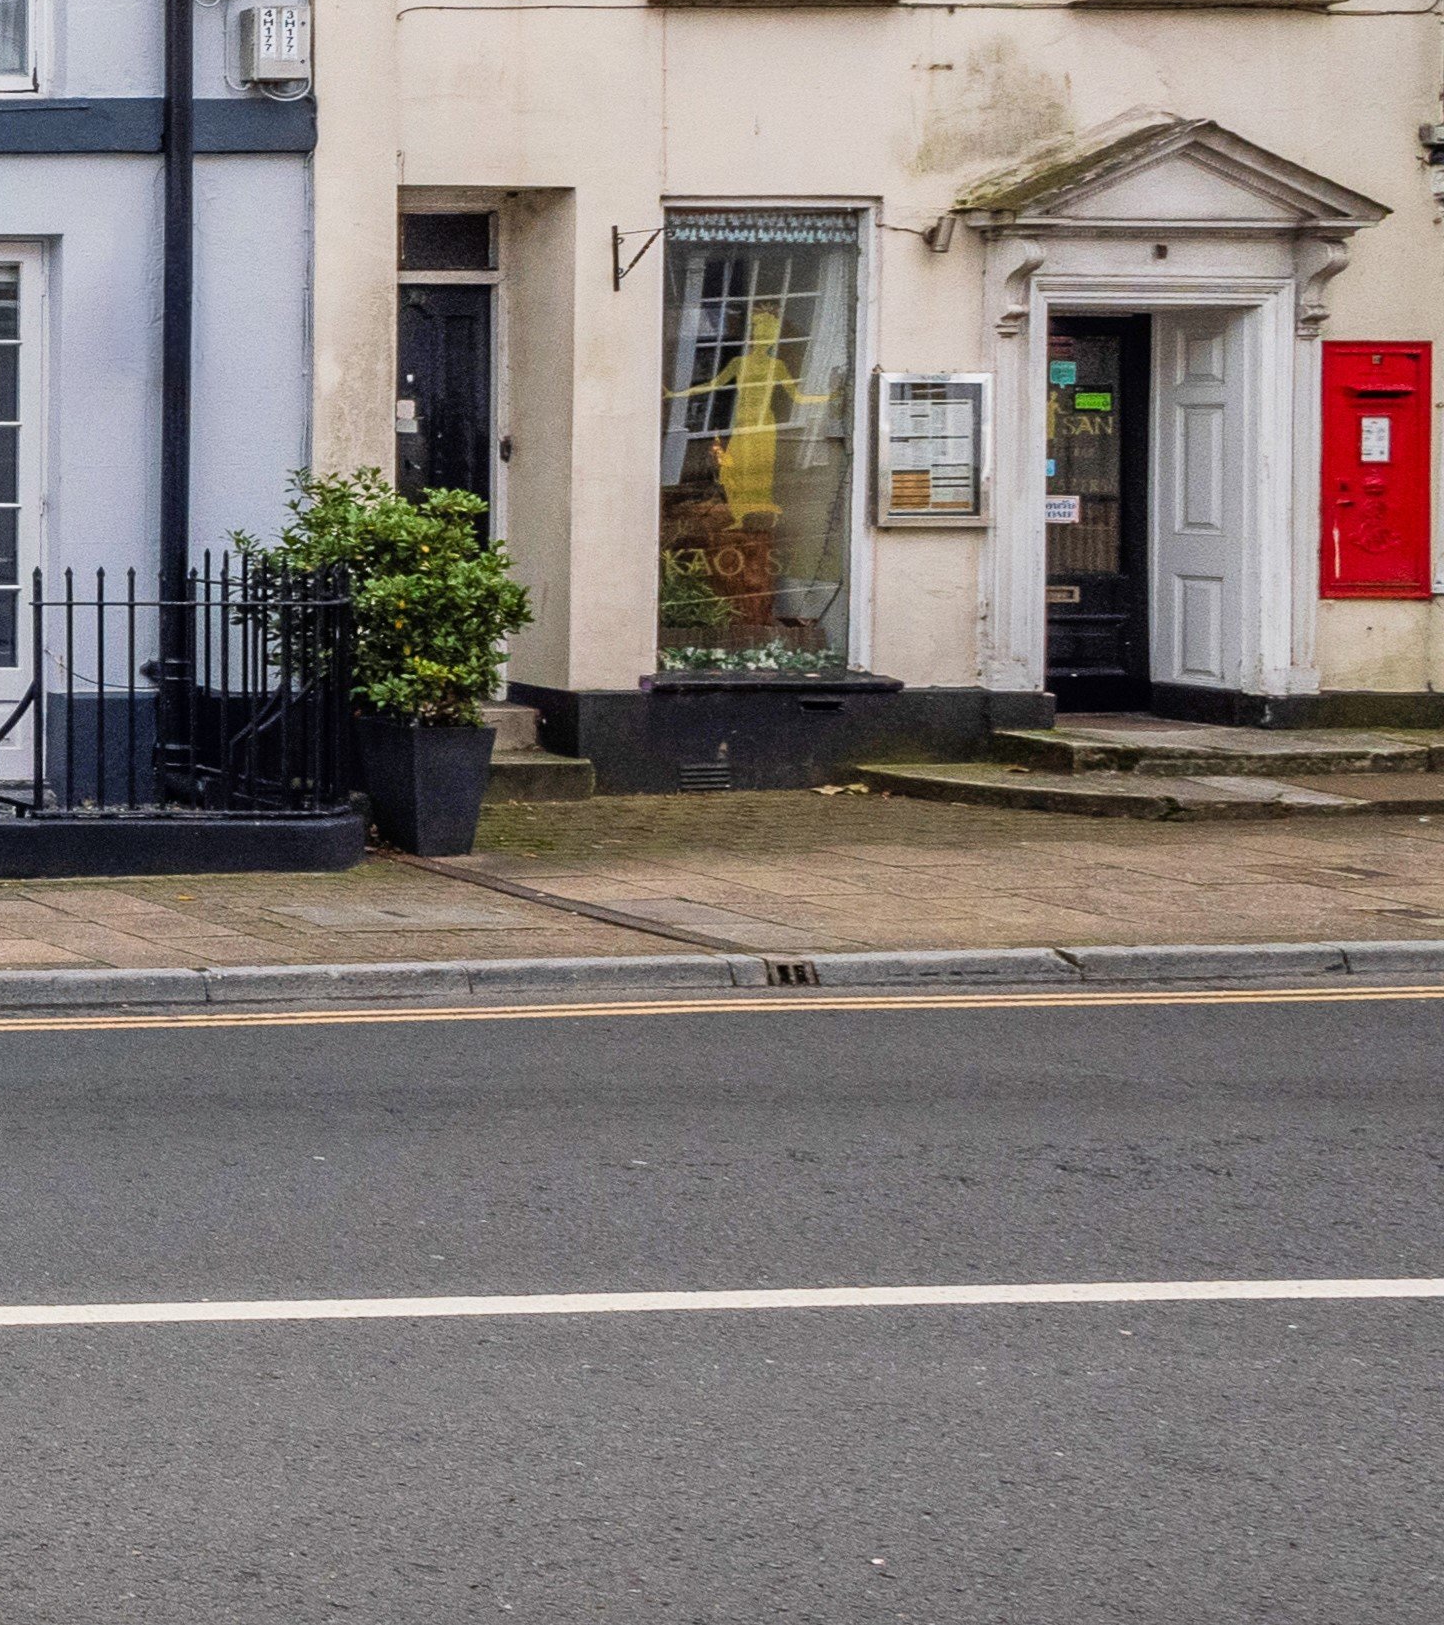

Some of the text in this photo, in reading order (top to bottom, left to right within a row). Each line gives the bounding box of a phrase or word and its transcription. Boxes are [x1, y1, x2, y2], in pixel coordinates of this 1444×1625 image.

[263, 9, 274, 51] 4H177
[284, 10, 295, 53] 3H177
[1061, 415, 1115, 436] SAN
[661, 547, 745, 577] KAO
